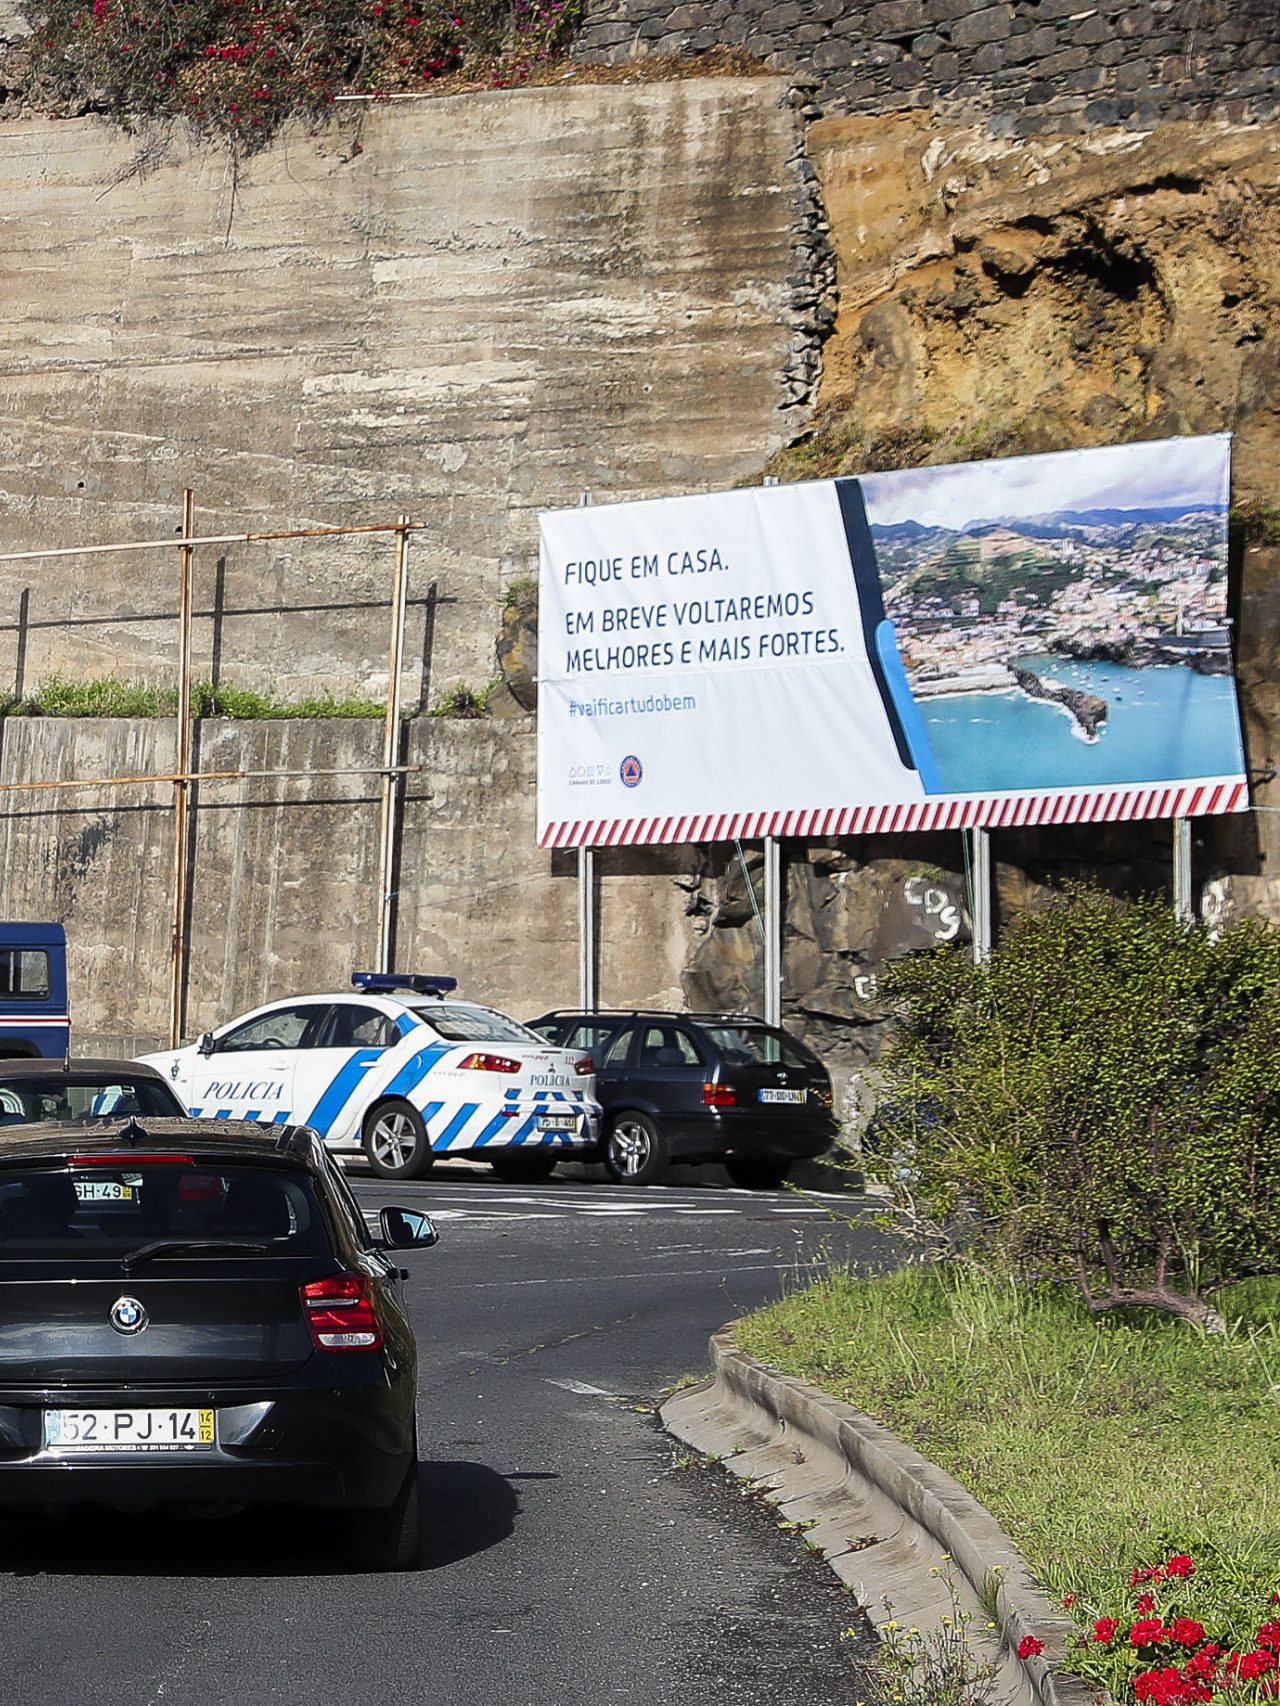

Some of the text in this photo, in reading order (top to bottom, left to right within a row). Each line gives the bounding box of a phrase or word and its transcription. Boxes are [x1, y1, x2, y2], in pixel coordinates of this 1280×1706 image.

[564, 548, 729, 587] FIQUE EM CASA.
[565, 591, 814, 635] EM BREVE VOLTAREMOS
[566, 628, 845, 673] MELHORES E MAIS FORTES.
[569, 694, 696, 717] #vaificartudobem
[904, 877, 961, 940] CDS
[202, 1081, 285, 1100] POLICIA
[530, 1074, 571, 1087] POLICIA
[200, 1412, 211, 1423] 14
[200, 1430, 212, 1440] 12
